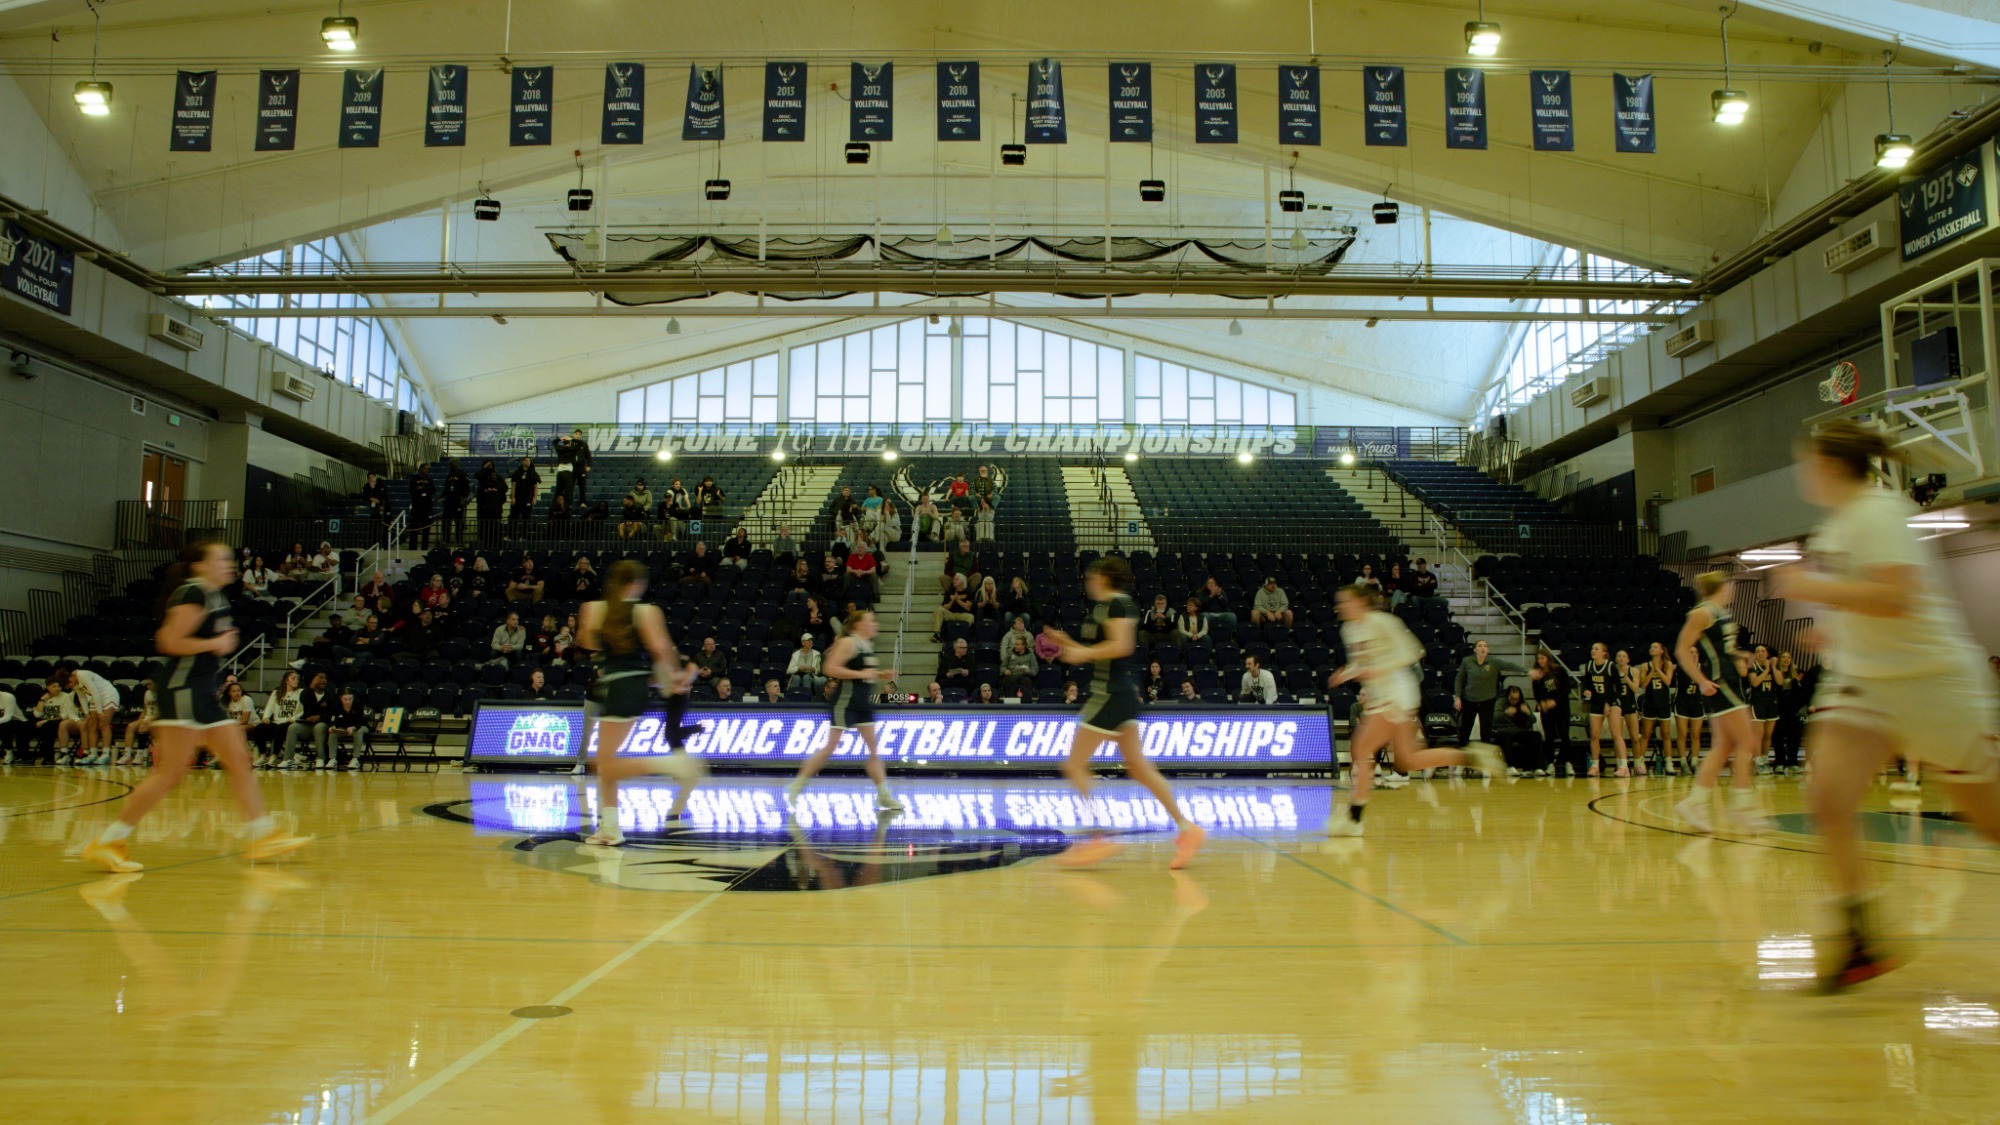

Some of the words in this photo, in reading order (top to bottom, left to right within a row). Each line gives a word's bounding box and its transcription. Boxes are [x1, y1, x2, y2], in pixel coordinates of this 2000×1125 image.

[439, 90, 455, 100] 2018
[523, 90, 541, 100] 2018
[616, 88, 632, 98] 2017
[777, 87, 795, 96] 2013
[863, 86, 881, 95] 2012
[949, 86, 967, 95] 2010
[1121, 87, 1140, 96] 2007
[1206, 89, 1226, 98] 2003
[1290, 90, 1309, 99] 2002
[186, 96, 202, 106] 2021
[269, 96, 286, 105] 2021
[354, 92, 371, 102] 2019
[1376, 92, 1393, 101] 2001
[1457, 93, 1474, 103] 1996
[1542, 95, 1560, 105] 1990
[608, 103, 640, 111] VOLLEYBALL
[691, 101, 720, 112] VOLLEYBALL
[768, 100, 802, 108] VOLLEYBALL
[855, 100, 888, 108] VOLLEYBALL
[942, 100, 975, 108] VOLLEYBALL
[1031, 100, 1060, 109] VOLLEYBALL
[1114, 101, 1147, 109] VOLLEYBALL
[1199, 102, 1233, 110] VOLLEYBALL
[1626, 97, 1642, 107] 1981
[346, 106, 378, 114] VOLLEYBALL
[431, 105, 463, 113] VOLLEYBALL
[515, 104, 548, 112] VOLLEYBALL
[1283, 103, 1316, 112] VOLLEYBALL
[1449, 108, 1482, 116] VOLLEYBALL
[178, 110, 210, 118] VOLLEYBALL
[1536, 109, 1568, 117] VOLLEYBALL
[1618, 112, 1650, 120] VOLLEYBALL
[1921, 169, 1954, 211] 1973
[1928, 210, 1947, 225] ELITE
[1904, 230, 1936, 256] WOMEN'S
[1937, 209, 1981, 241] BASKETBALL
[22, 239, 56, 274] 2021
[38, 276, 58, 288] FOUR
[17, 275, 59, 307] VOLLEYBALL
[498, 437, 535, 451] GNAC
[588, 428, 758, 452] WELCOME
[773, 428, 815, 452] TO
[825, 428, 888, 452] THE
[900, 428, 995, 453] GNAC
[1004, 428, 1298, 455] CHAMPIONSHIPS
[330, 520, 339, 531] D
[691, 522, 700, 532] C
[1128, 521, 1137, 533] B
[1520, 526, 1530, 537] A
[1652, 678, 1662, 690] 15
[1762, 682, 1772, 692] 14
[510, 730, 566, 751] GNAC
[685, 719, 784, 754] GNAC
